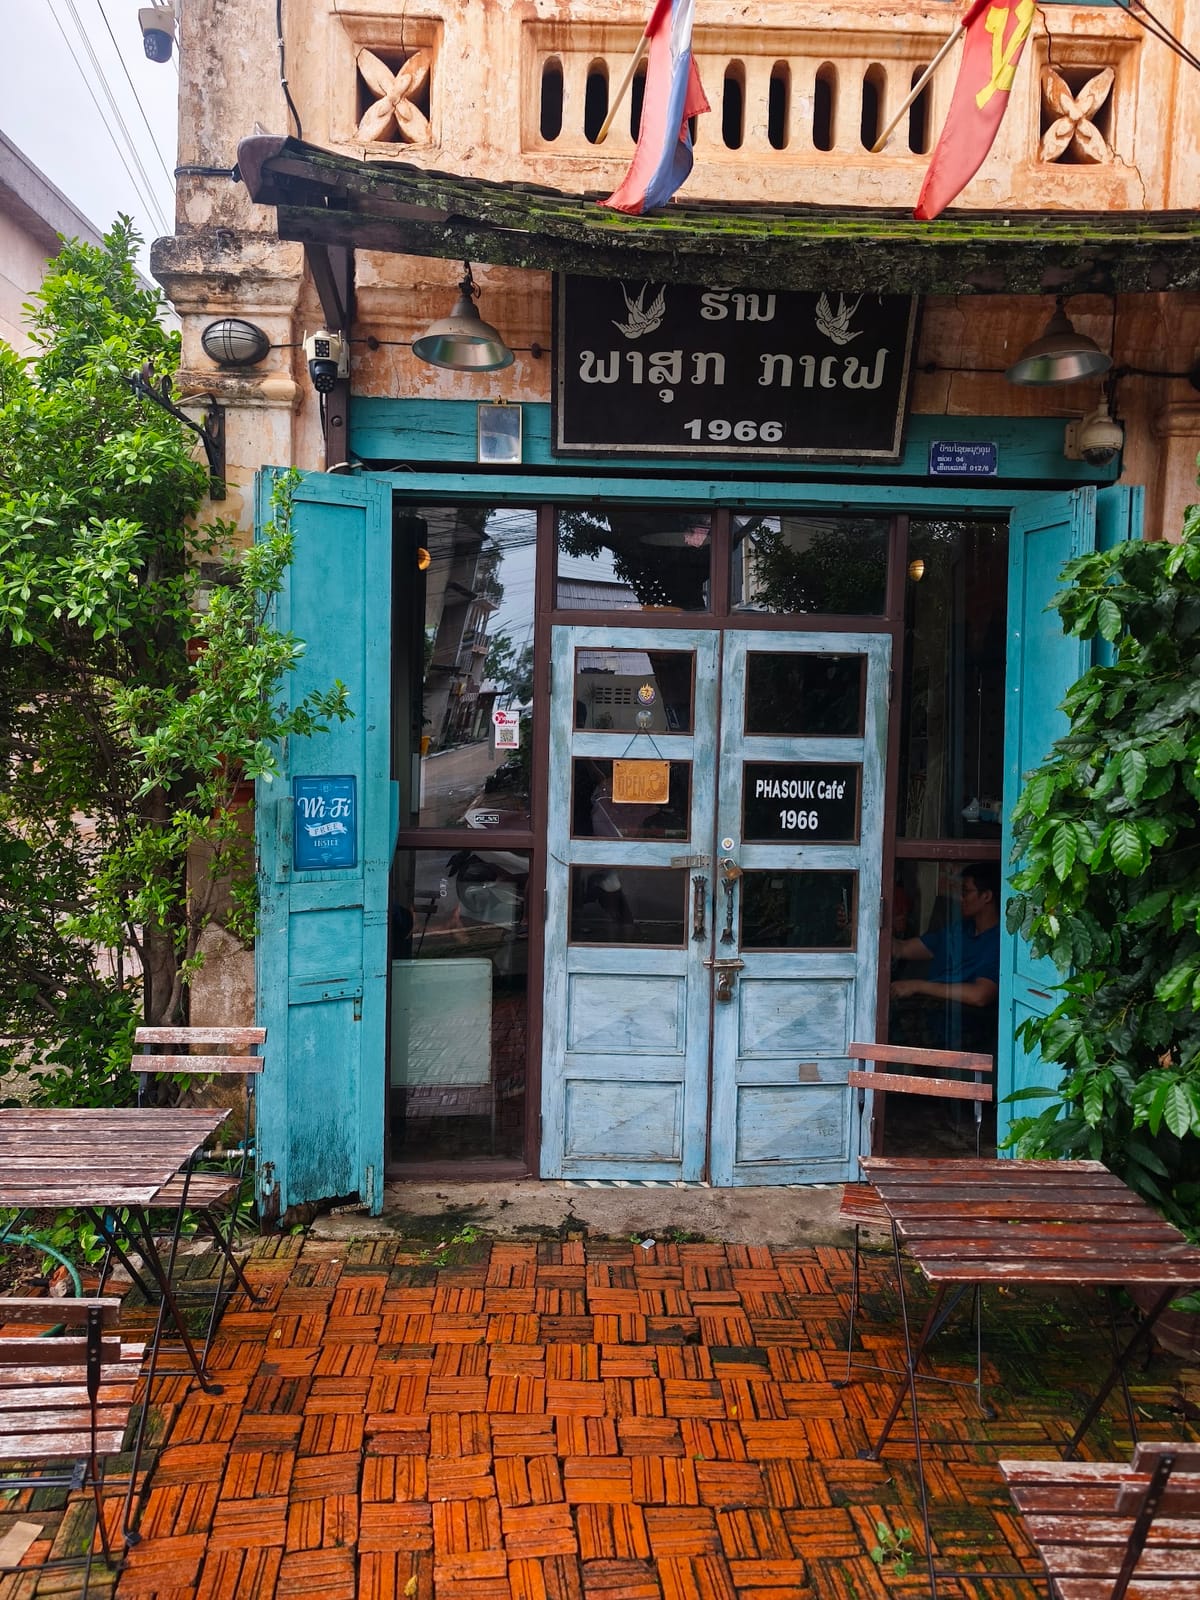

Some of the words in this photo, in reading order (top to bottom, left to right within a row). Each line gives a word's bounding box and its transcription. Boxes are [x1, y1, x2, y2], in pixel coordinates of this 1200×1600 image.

[579, 349, 727, 404] ພາສຸກ
[758, 347, 890, 390] ກາເຟ
[683, 418, 783, 442] 1966
[617, 775, 645, 796] OPEN
[755, 779, 816, 799] PHASOUK
[314, 823, 338, 835] FREE
[779, 809, 819, 830] 1966
